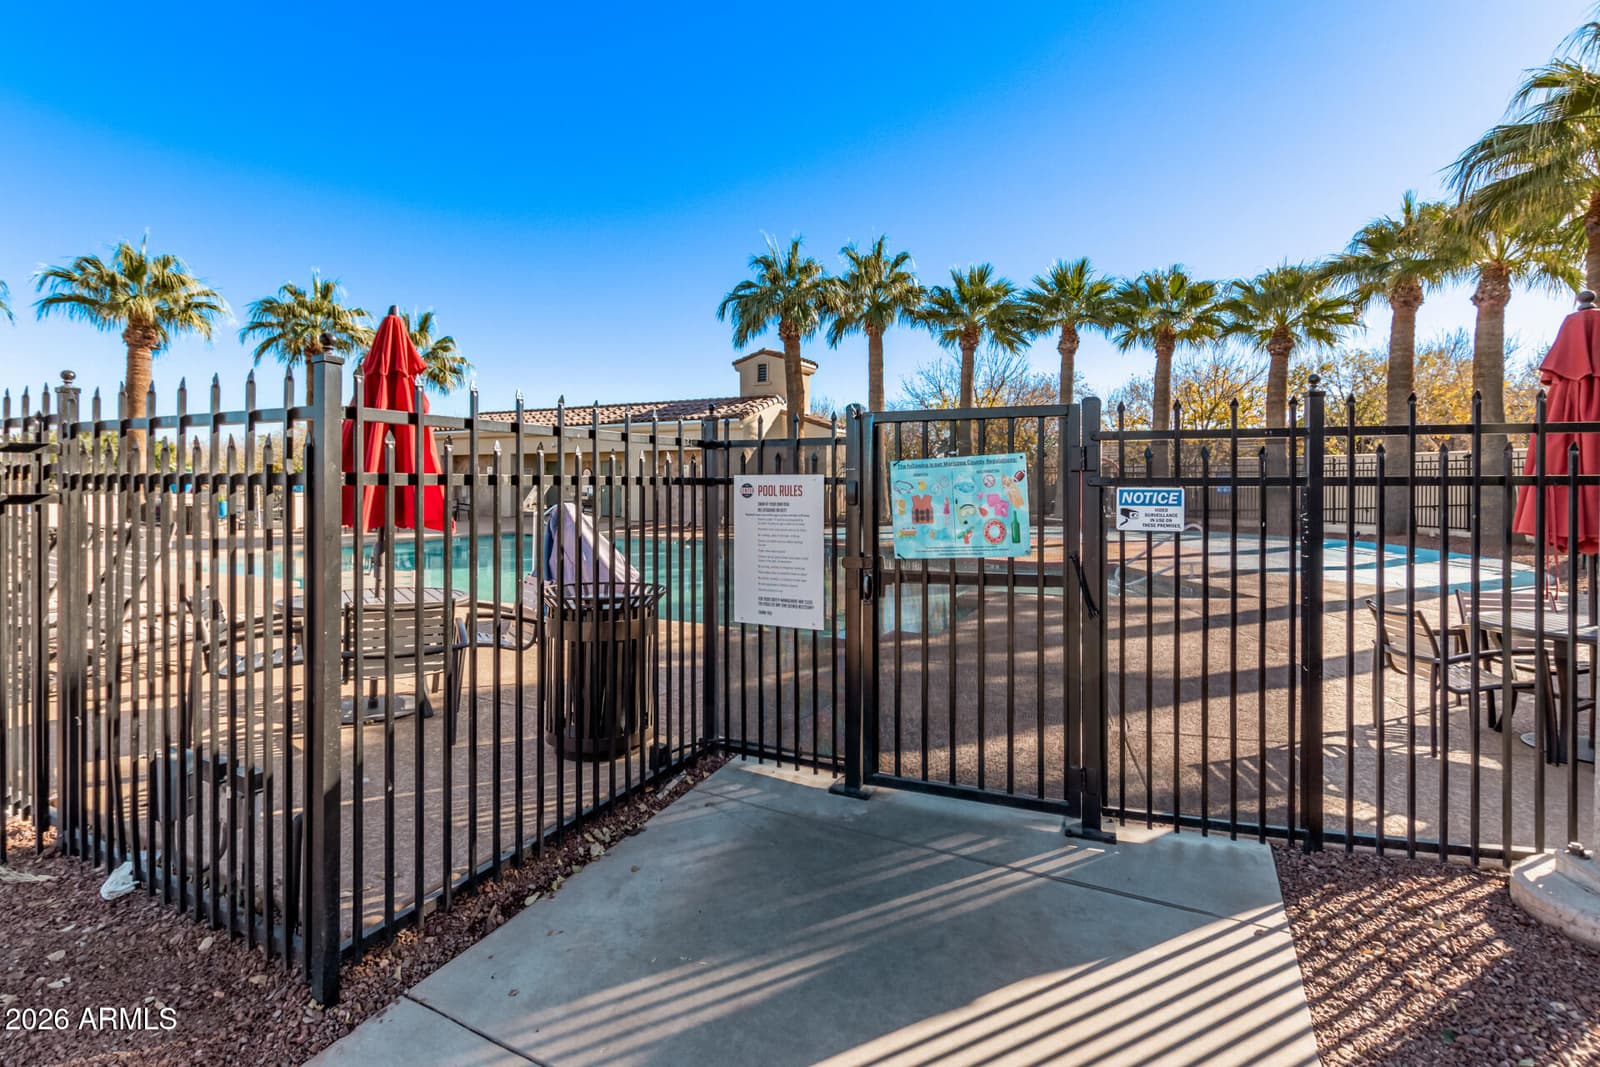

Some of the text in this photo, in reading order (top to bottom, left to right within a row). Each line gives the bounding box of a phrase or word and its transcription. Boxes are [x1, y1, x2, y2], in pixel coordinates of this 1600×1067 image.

[758, 484, 778, 496] POOL
[780, 484, 803, 496] RULES
[1122, 492, 1179, 504] NOTICE
